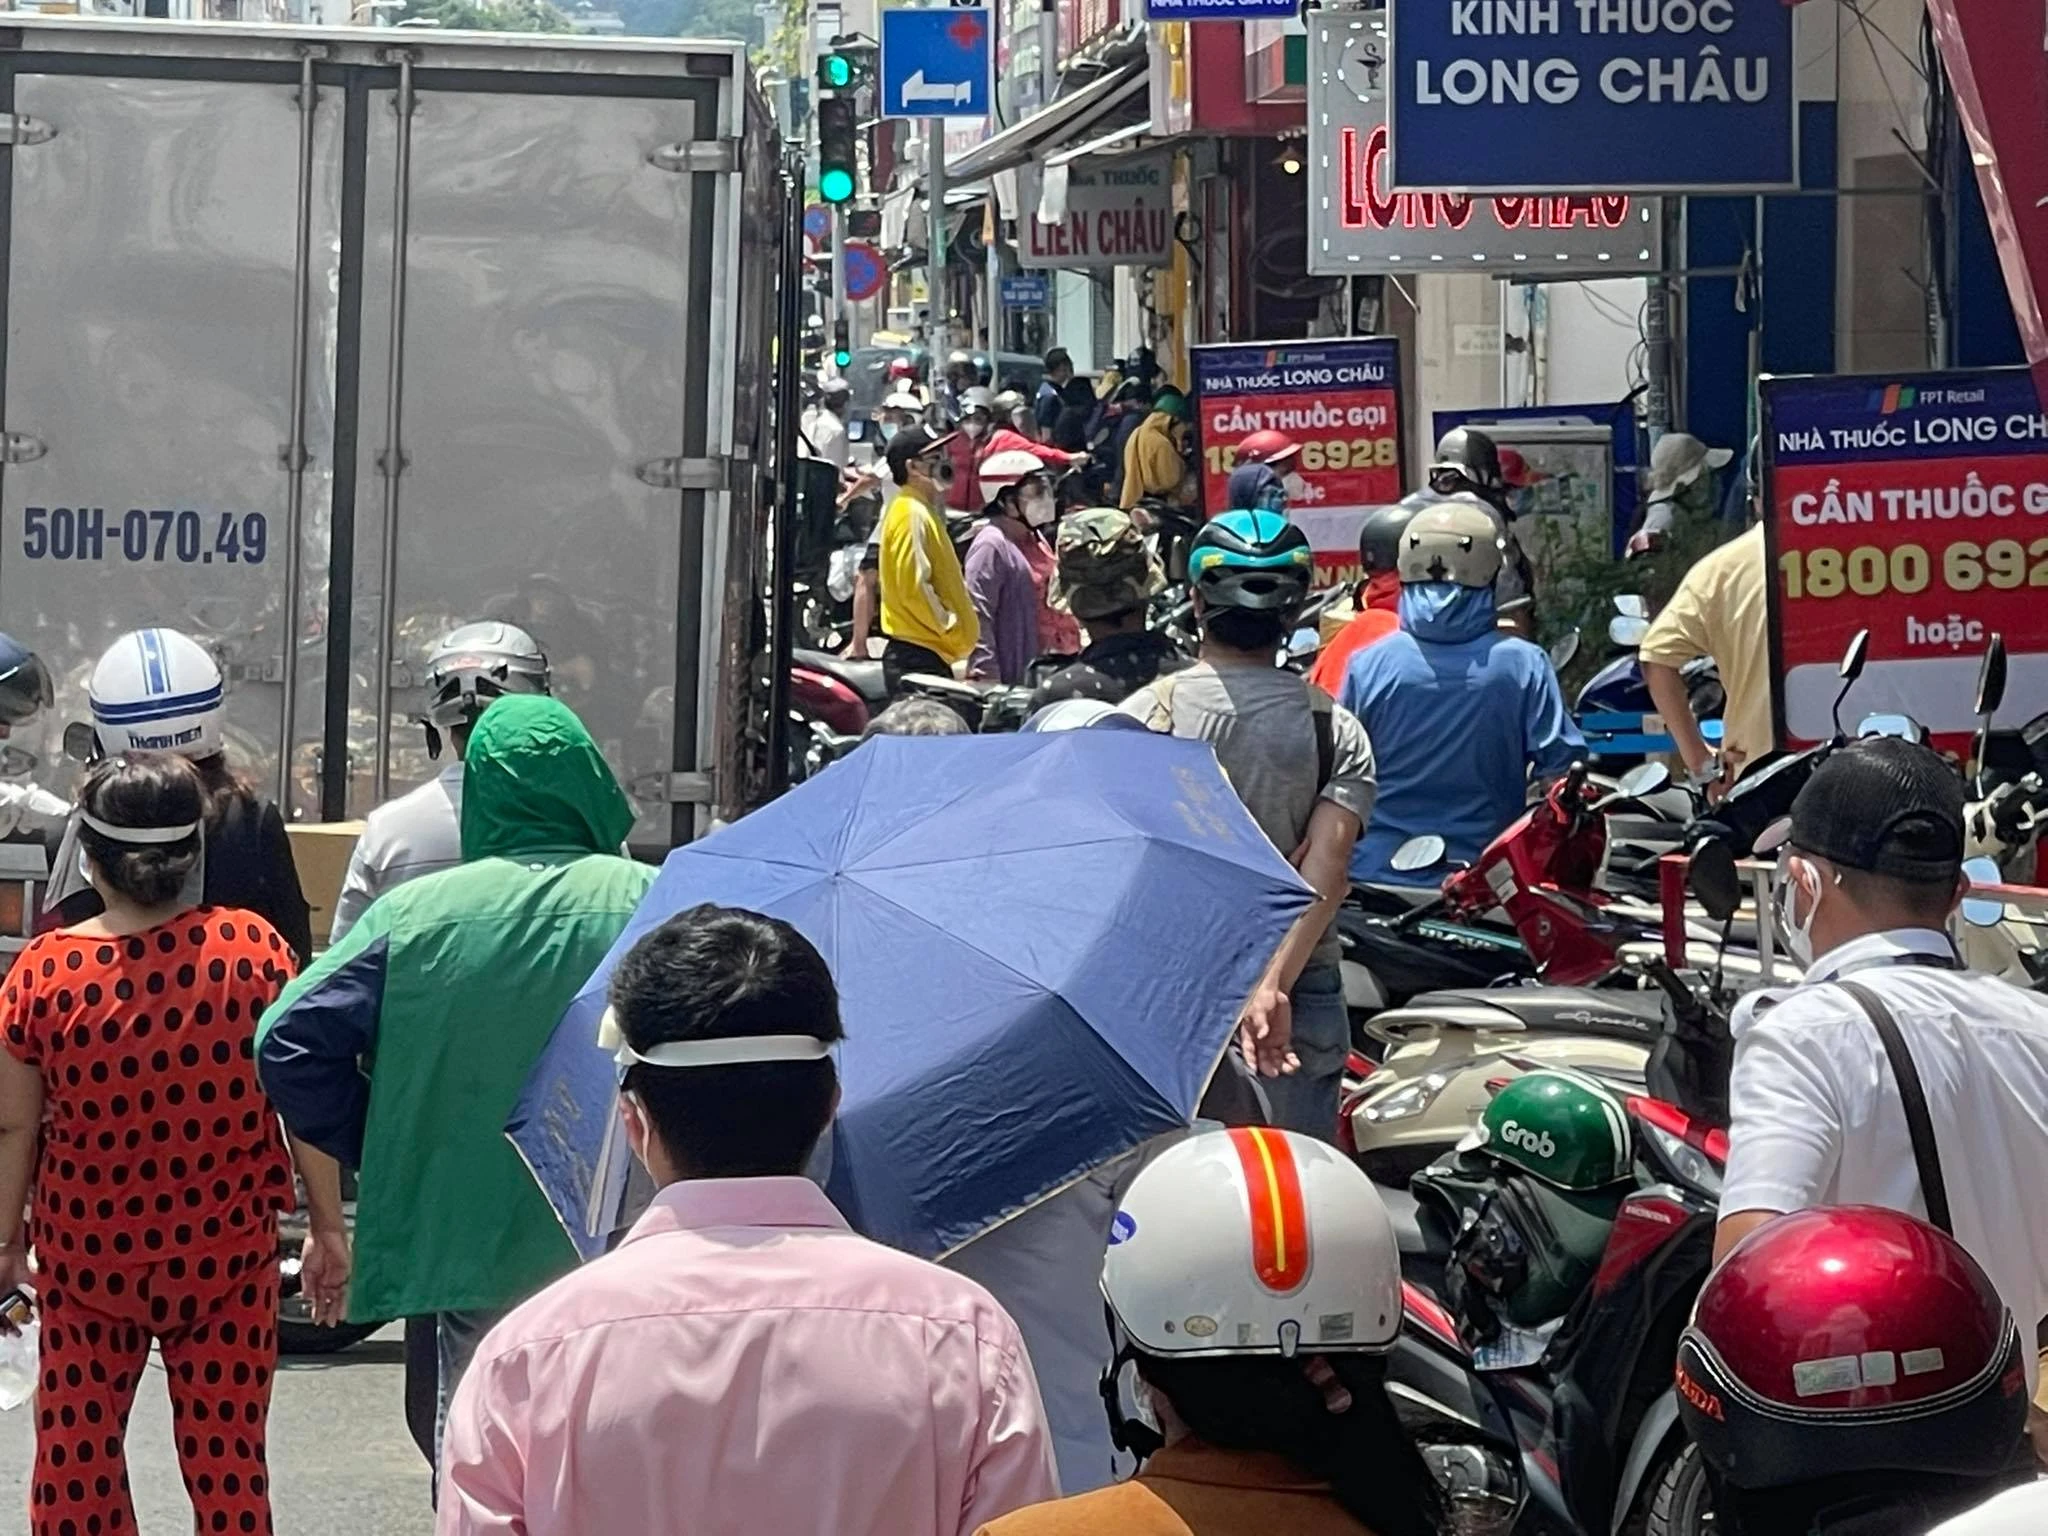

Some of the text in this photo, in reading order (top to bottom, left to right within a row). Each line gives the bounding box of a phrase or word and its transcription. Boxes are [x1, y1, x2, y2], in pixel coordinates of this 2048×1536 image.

[1416, 44, 1768, 105] LONG CHÂU
[1097, 196, 1166, 255] CHÂU
[1206, 363, 1385, 390] NHÀ THUỐC LONG CHÂU
[1919, 389, 1985, 404] FPT Retail
[1213, 400, 1387, 433] CẦN THUỐC GỌI
[1779, 427, 1825, 451] NHÀ
[1830, 420, 1906, 449] THUỐC
[1914, 416, 1998, 444] LONG
[1302, 438, 1397, 470] 6928
[1791, 478, 1874, 526] CẦN
[1880, 471, 2016, 521] THUỐC
[23, 507, 267, 564] 50H-070.49
[1779, 544, 1930, 599] 1800
[1906, 614, 1984, 650] hoặc
[1501, 1119, 1556, 1158] Grab
